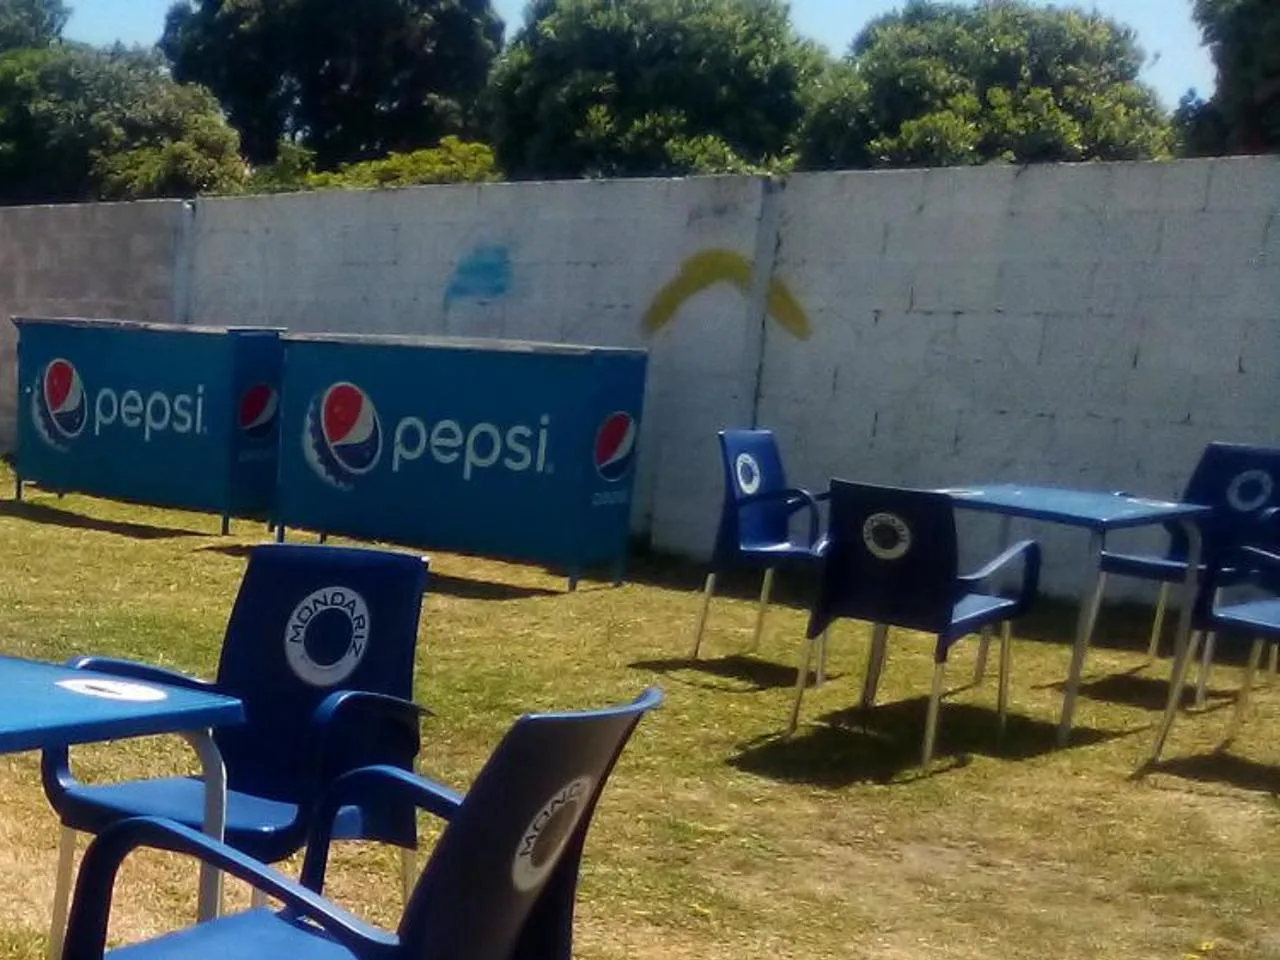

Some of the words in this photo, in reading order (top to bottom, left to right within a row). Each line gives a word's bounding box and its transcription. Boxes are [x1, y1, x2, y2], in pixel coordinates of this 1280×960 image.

[94, 384, 206, 442] pepsi
[392, 414, 550, 481] pepsi
[289, 592, 366, 657] MONDARIZ
